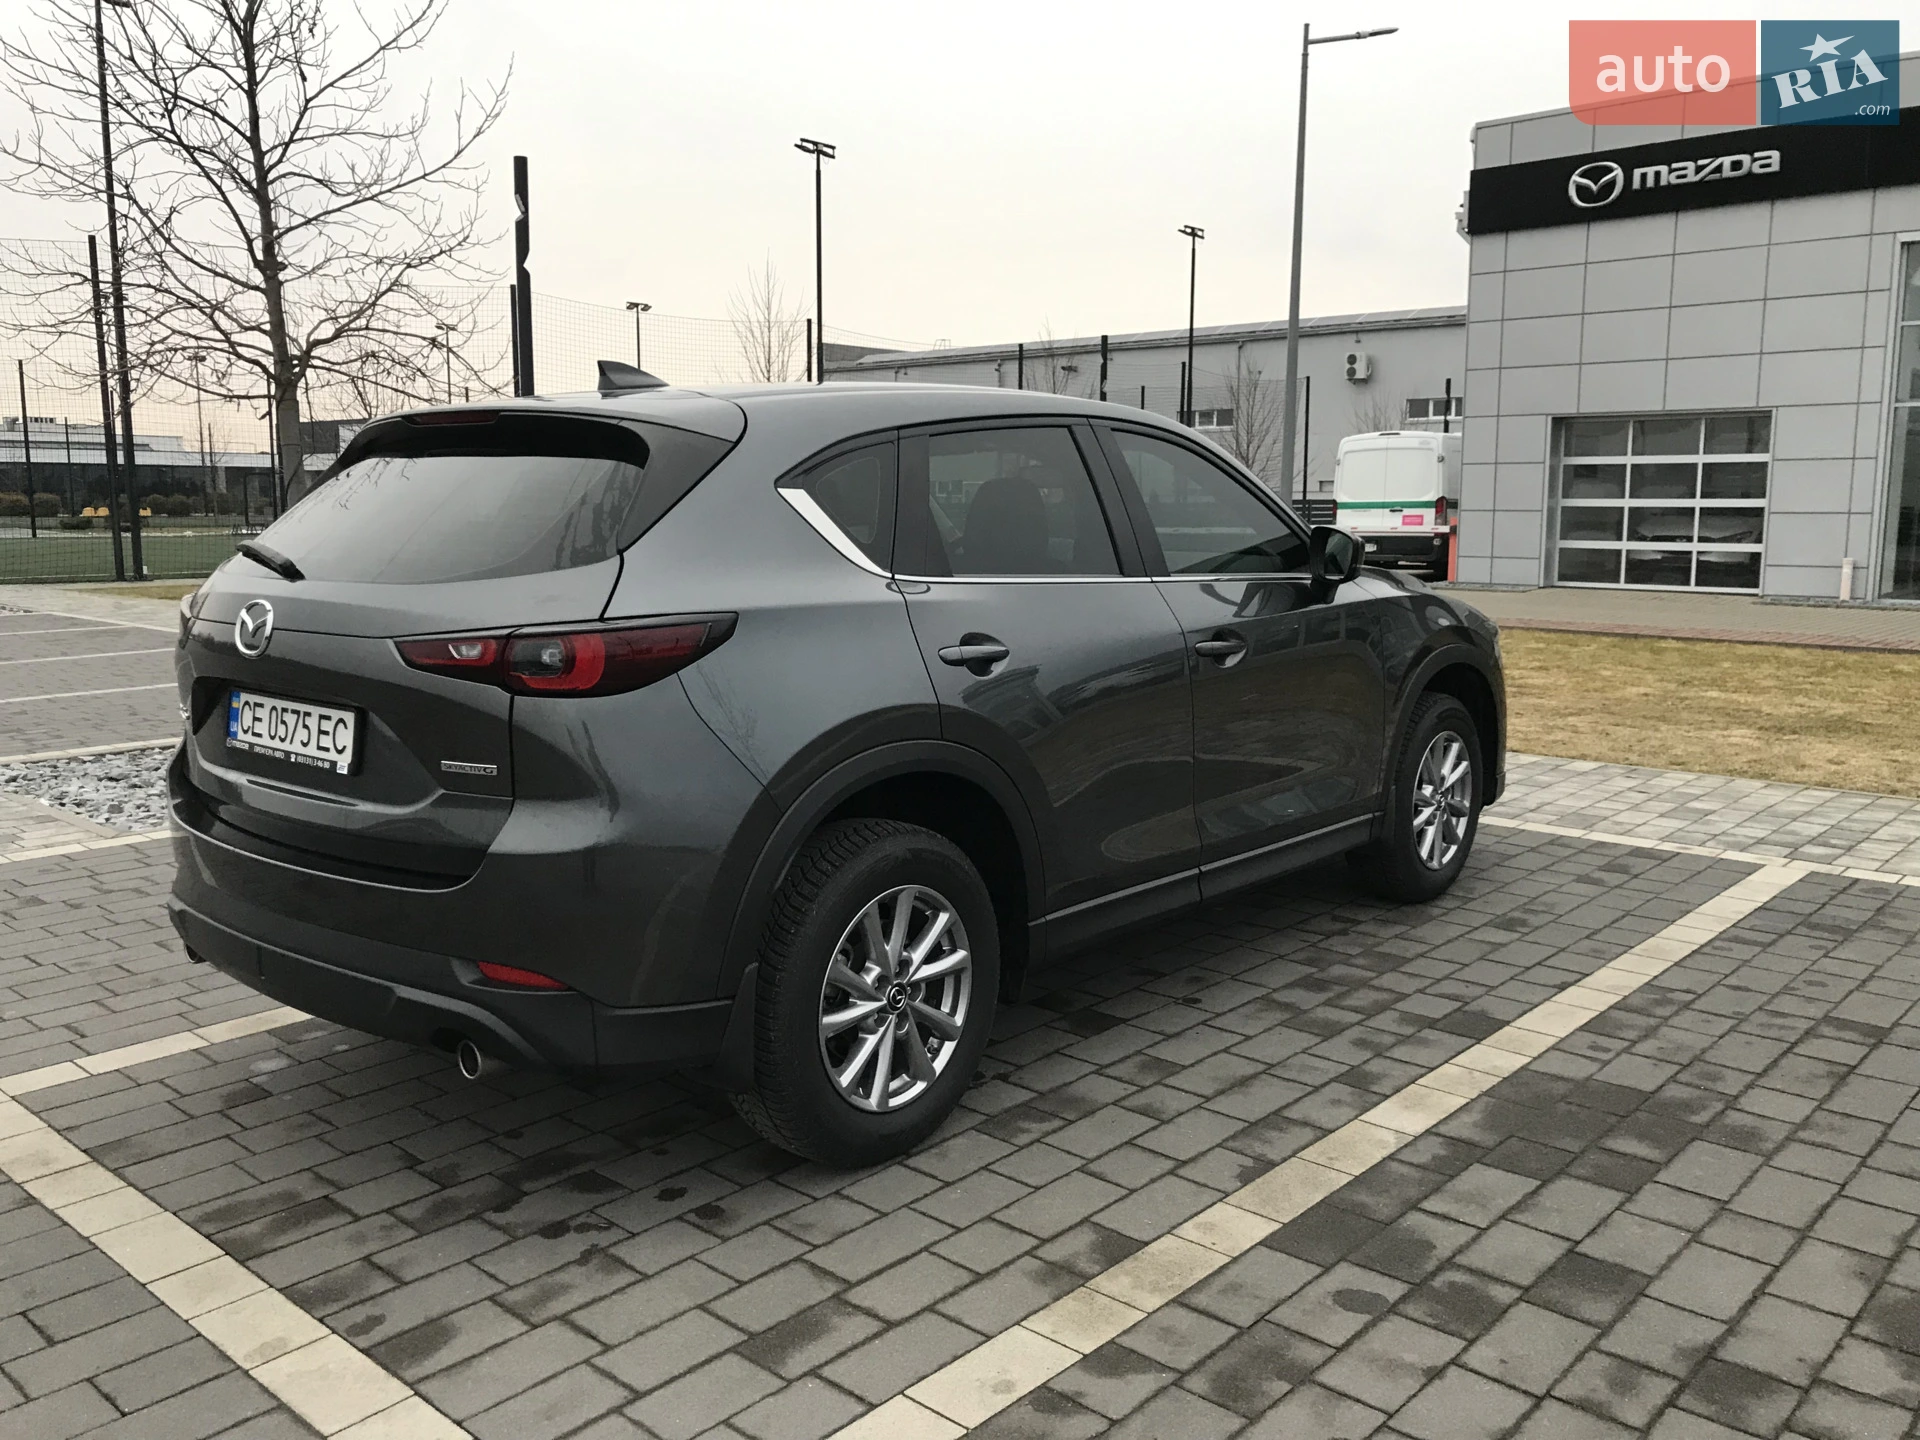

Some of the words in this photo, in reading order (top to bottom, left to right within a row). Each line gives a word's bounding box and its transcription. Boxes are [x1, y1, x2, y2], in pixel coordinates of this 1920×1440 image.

[240, 700, 265, 738] CE
[268, 705, 312, 748] 0575
[316, 713, 348, 755] EC
